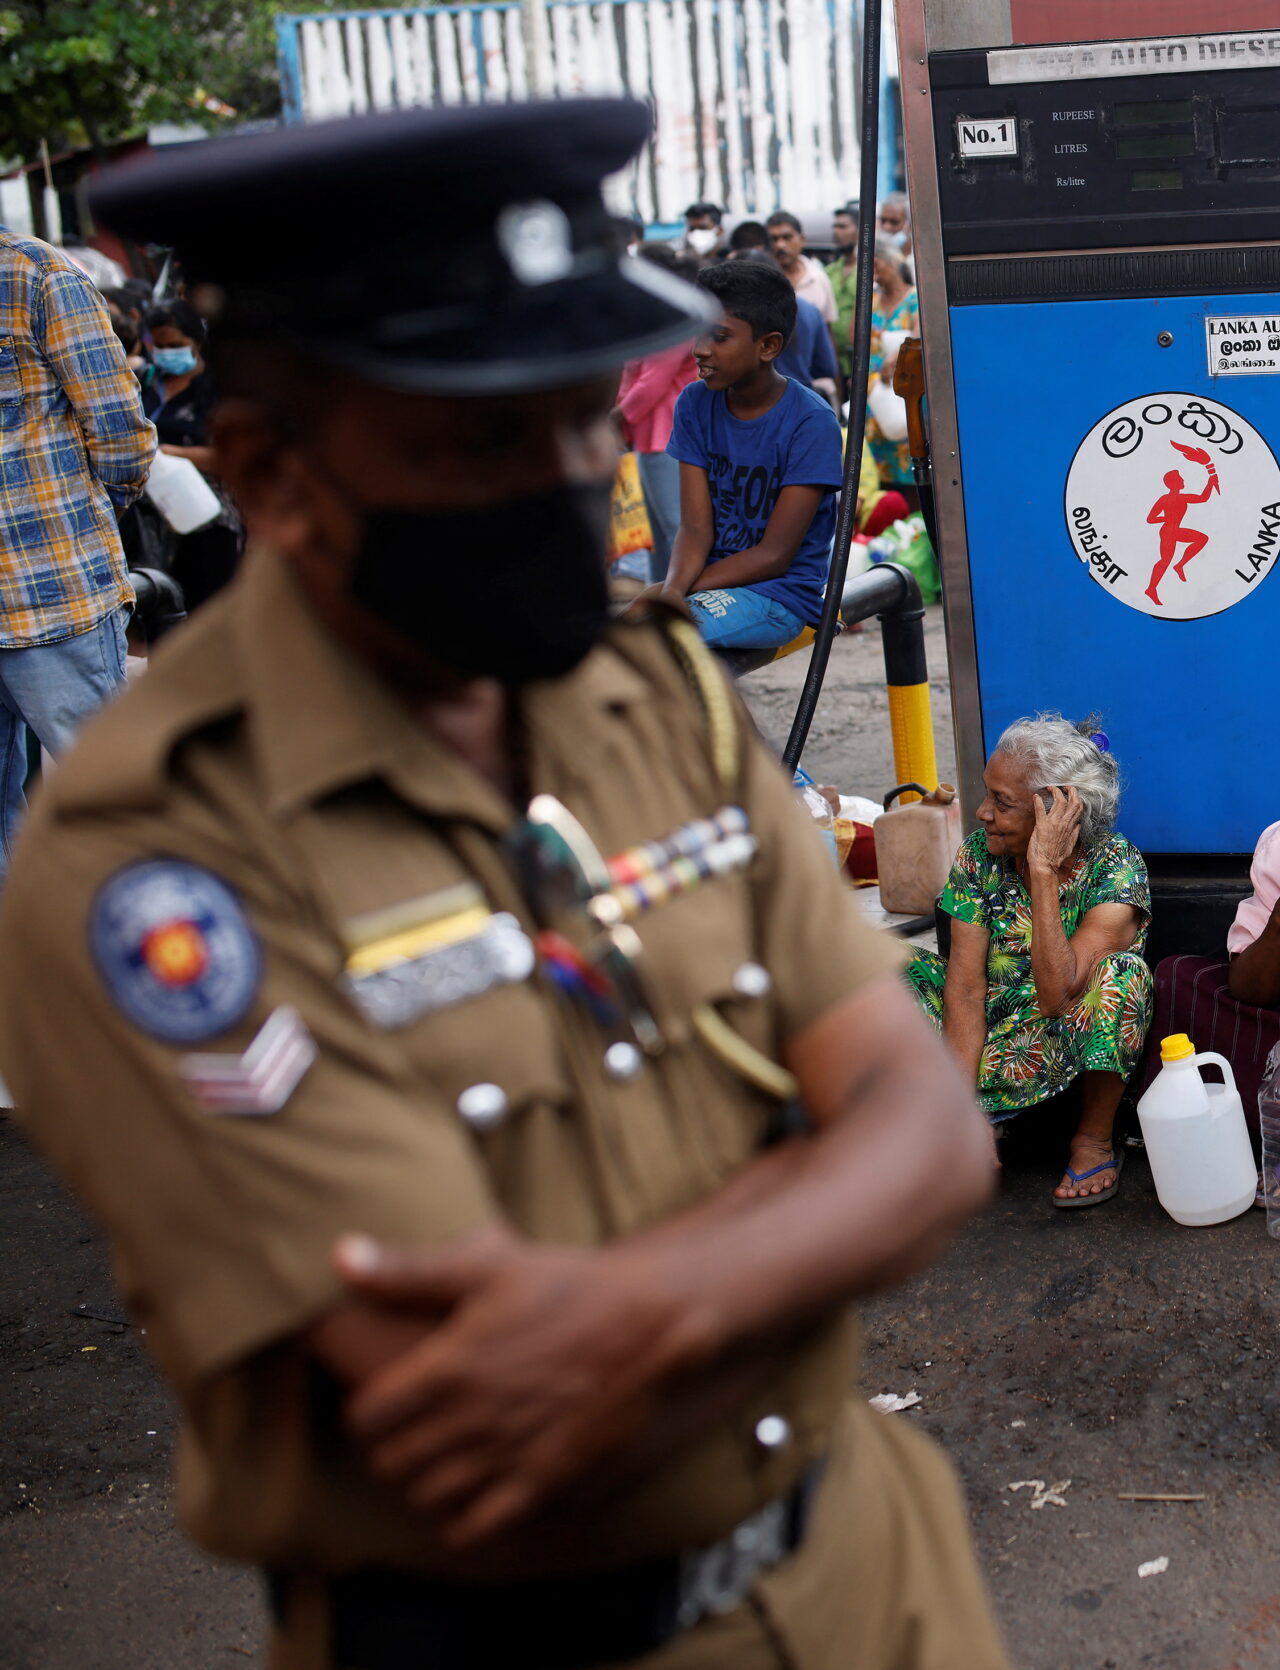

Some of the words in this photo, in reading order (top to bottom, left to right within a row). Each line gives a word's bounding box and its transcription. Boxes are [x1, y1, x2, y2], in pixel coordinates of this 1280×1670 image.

[1110, 44, 1188, 66] AUTO
[1052, 110, 1096, 121] RUPEESE
[1054, 143, 1088, 154] LITRES
[1056, 177, 1086, 187] Rs/litre
[1210, 321, 1258, 336] LANKA
[1220, 340, 1262, 356] ලංකා
[1218, 358, 1276, 370] இலங்கை
[1101, 401, 1244, 458] ලංකා
